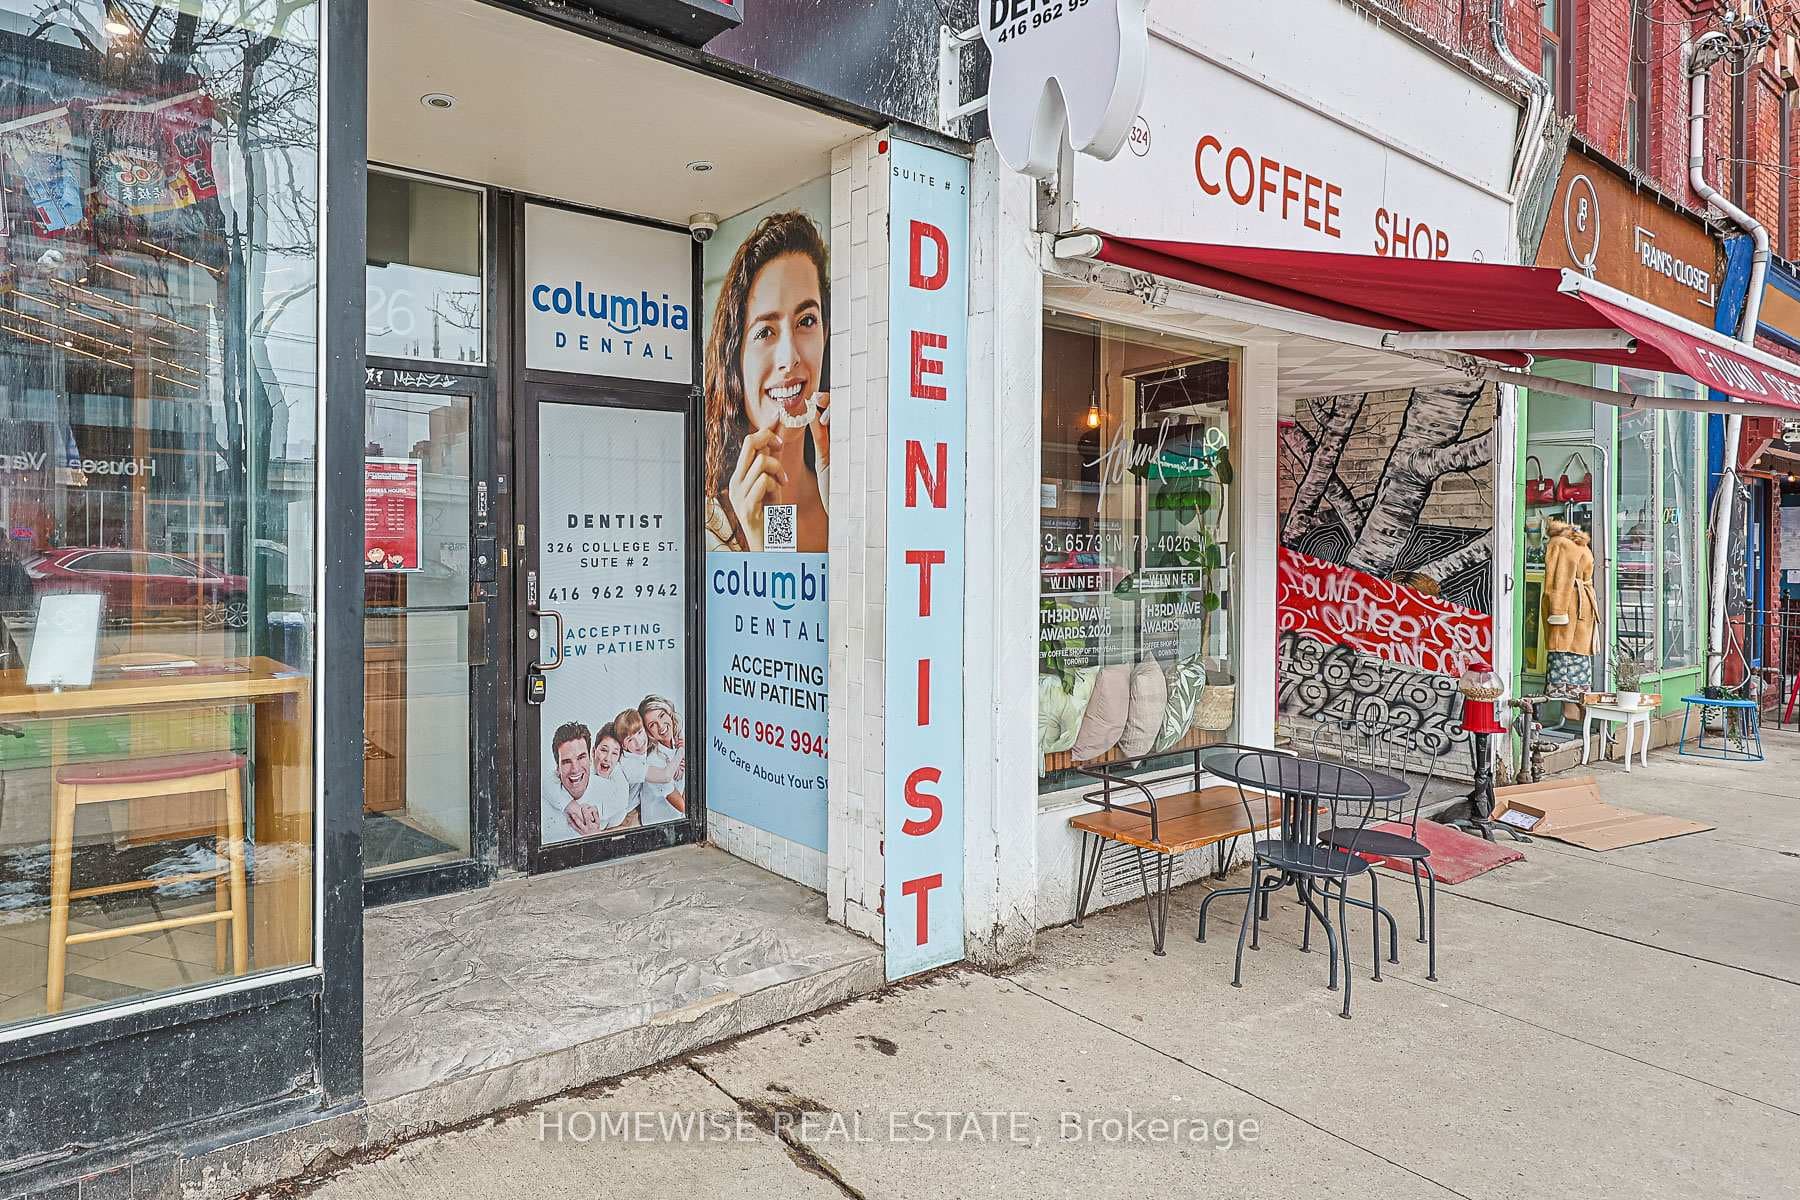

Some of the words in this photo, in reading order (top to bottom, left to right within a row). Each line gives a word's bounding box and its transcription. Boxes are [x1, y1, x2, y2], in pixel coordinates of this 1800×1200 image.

[998, 19, 1027, 43] 416
[1033, 3, 1063, 28] 962
[1130, 126, 1148, 146] 324
[892, 166, 937, 188] SUITE
[960, 185, 966, 196] 2
[1194, 134, 1342, 239] COFFEE
[1374, 207, 1449, 260] SHOP
[1674, 260, 1710, 295] CLOSET
[532, 281, 688, 331] columbia
[555, 331, 673, 360] DENTAL
[1695, 346, 1768, 396] FOUND
[567, 514, 663, 529] DENTIST
[547, 543, 573, 553] 326
[582, 542, 650, 553] COLLEGE
[658, 541, 678, 552] ST.
[580, 557, 618, 568] SUTE
[642, 557, 649, 567] 2
[900, 219, 951, 947] DENTIST
[1049, 575, 1104, 589] WINNER
[1149, 572, 1194, 586] WINNER
[548, 587, 580, 601] 416
[592, 585, 624, 599] 962
[635, 584, 678, 598] 9942
[1040, 606, 1111, 624] TH3RDWAVE
[566, 623, 661, 640] ACCEPTING
[735, 615, 825, 643] DENTAL
[1040, 627, 1086, 642] AWARDS
[1141, 619, 1179, 634] AWARDS
[550, 644, 587, 658] NEW
[597, 638, 675, 654] PATIENTS
[1048, 648, 1069, 658] COFFEE
[731, 654, 824, 686] ACCEPTING
[723, 675, 756, 698] NEW
[722, 713, 750, 739] 416
[755, 720, 785, 748] 962
[713, 736, 727, 756] We
[729, 750, 751, 772] Care
[753, 765, 786, 786] About
[787, 773, 814, 790] Your
